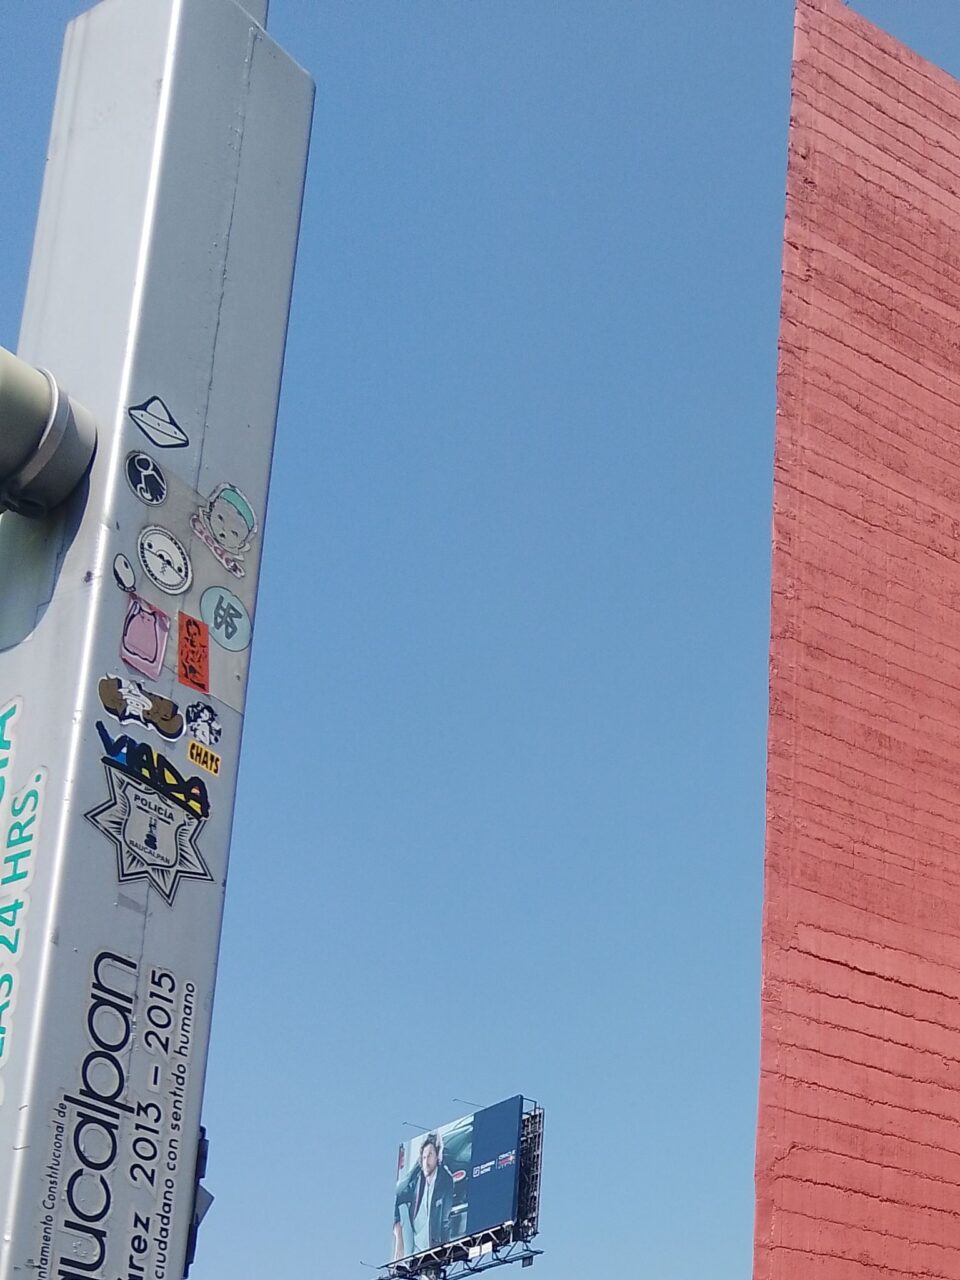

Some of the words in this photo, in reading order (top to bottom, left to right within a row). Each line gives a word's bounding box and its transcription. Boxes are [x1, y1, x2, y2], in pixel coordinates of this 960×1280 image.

[190, 742, 220, 774] CHATS
[1, 773, 42, 886] HRS.
[145, 969, 176, 1055] 2015
[174, 982, 195, 1057] humano
[52, 1102, 67, 1119] de
[169, 1064, 187, 1132] sentido
[43, 1121, 65, 1210] Constitucional
[129, 1101, 162, 1187] 2013
[166, 1139, 179, 1171] con
[153, 1178, 174, 1280] ciudadano
